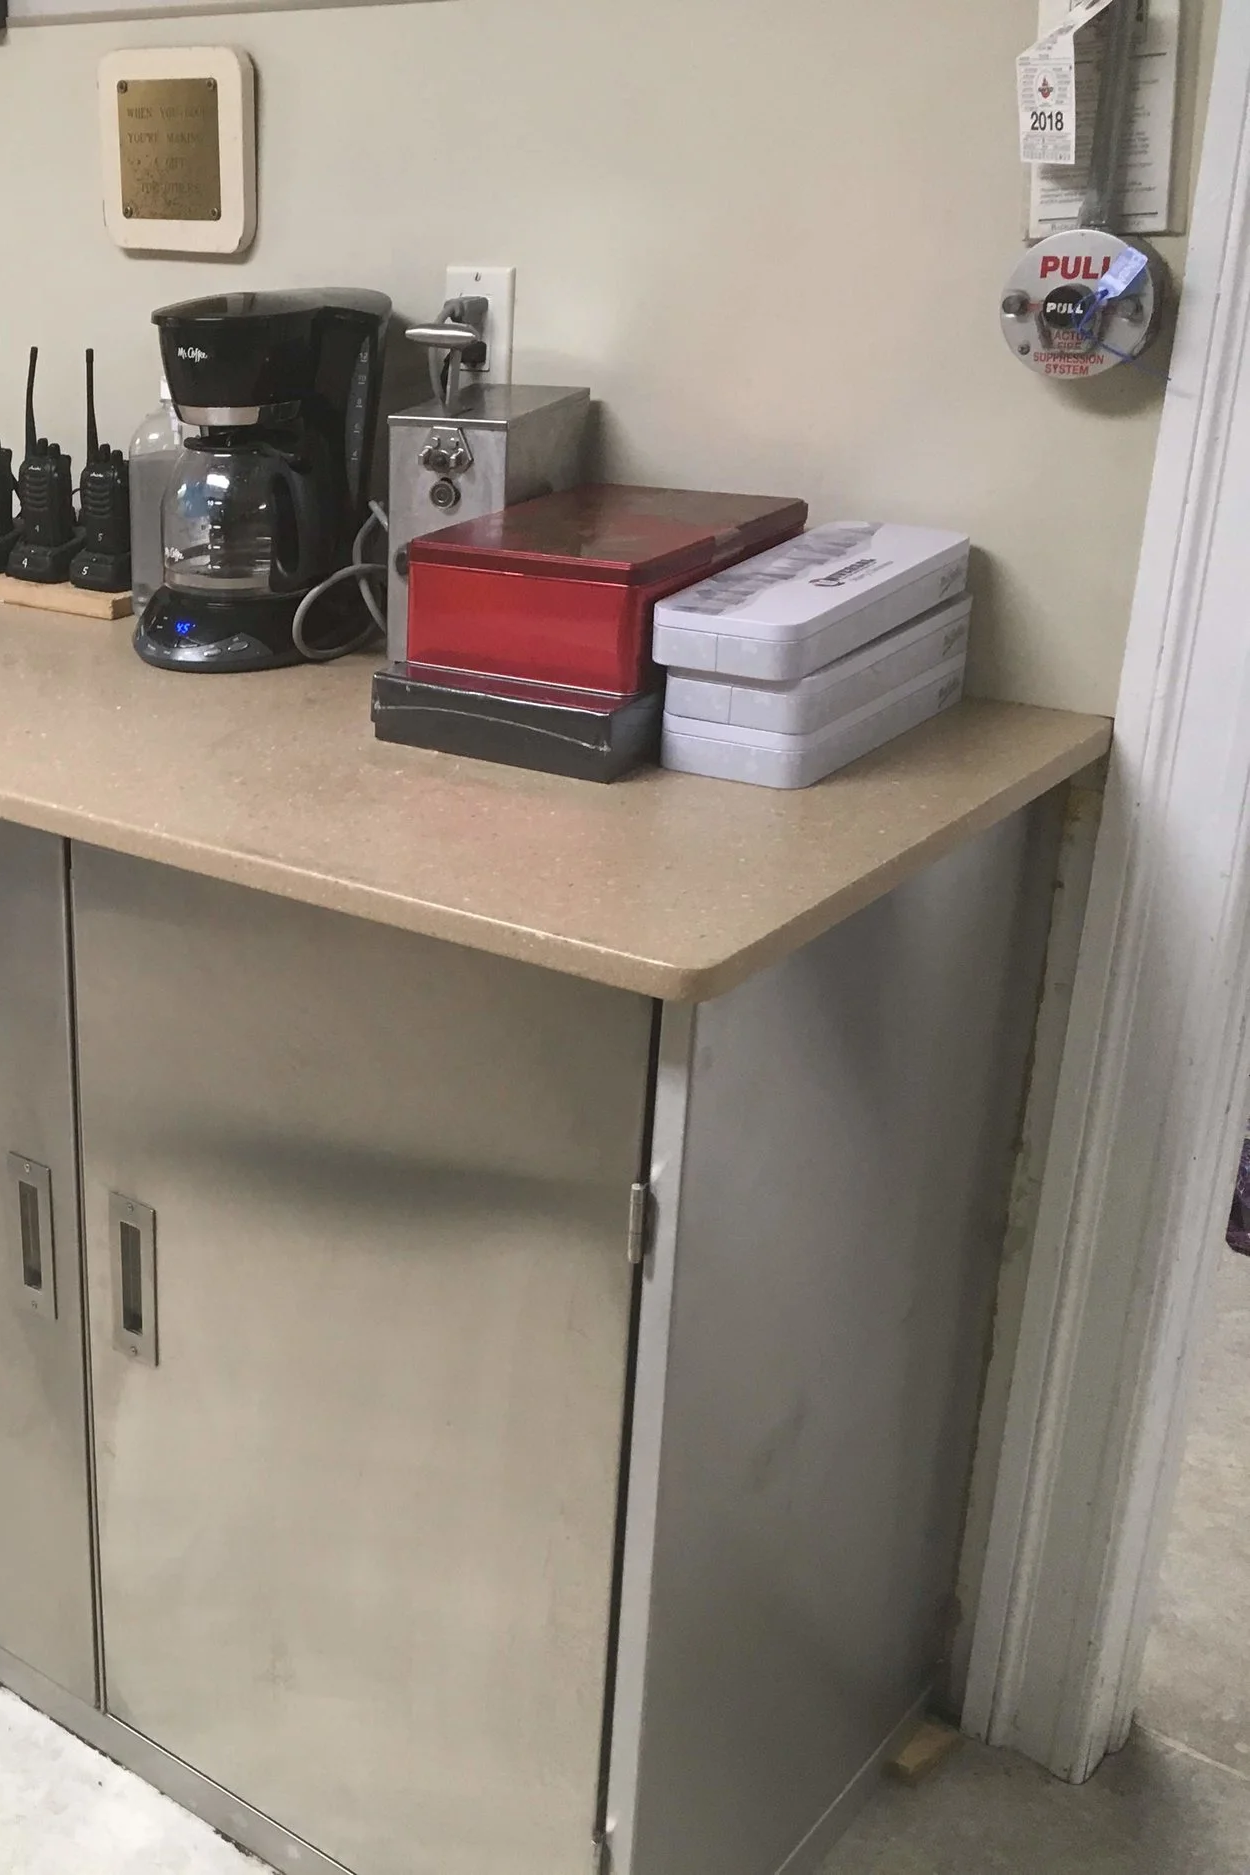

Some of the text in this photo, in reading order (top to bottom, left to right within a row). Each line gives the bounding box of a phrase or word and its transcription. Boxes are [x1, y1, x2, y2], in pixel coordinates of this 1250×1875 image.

[126, 106, 152, 119] WHEN
[1030, 110, 1064, 132] 2018
[1046, 302, 1084, 314] PULL
[1033, 352, 1105, 365] SUPPRESSION
[1045, 363, 1089, 375] SYSTEM
[21, 558, 28, 568] 4
[81, 566, 89, 576] 5
